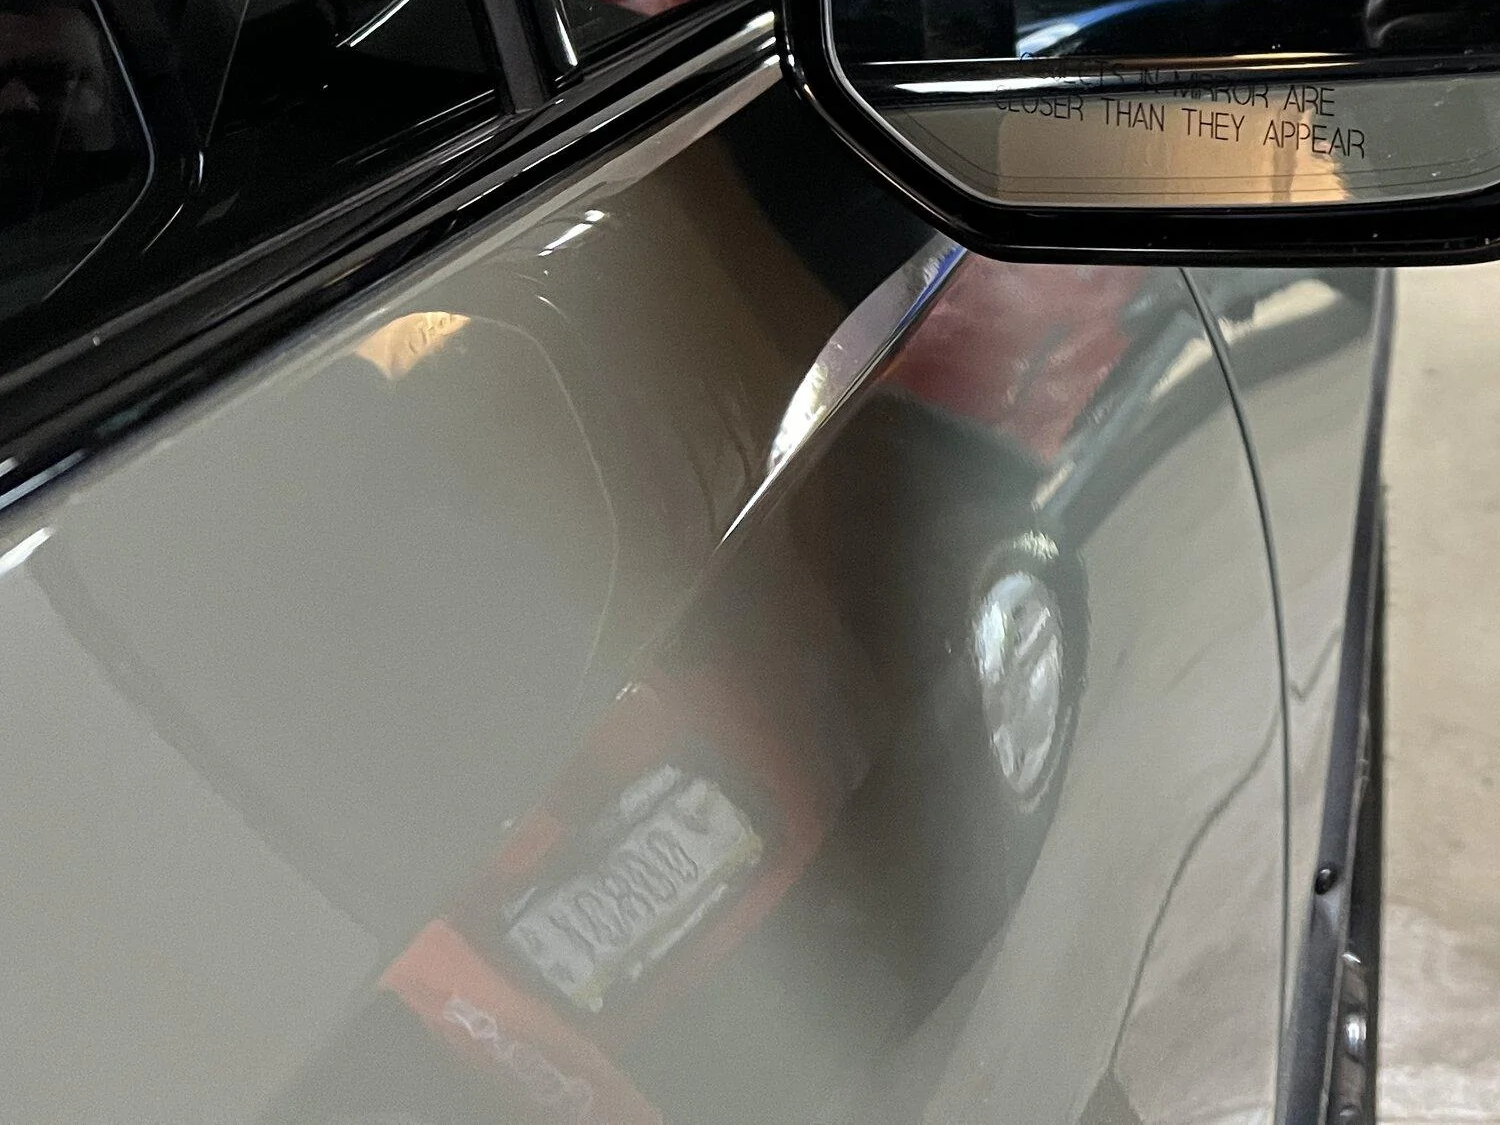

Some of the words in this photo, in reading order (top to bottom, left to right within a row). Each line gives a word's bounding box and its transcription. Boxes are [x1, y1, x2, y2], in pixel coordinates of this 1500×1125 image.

[995, 84, 1084, 121] CLOSER
[1101, 97, 1165, 132] THAN
[1182, 108, 1246, 143] THEY
[1262, 121, 1365, 159] APPEAR
[1284, 85, 1336, 118] ARE
